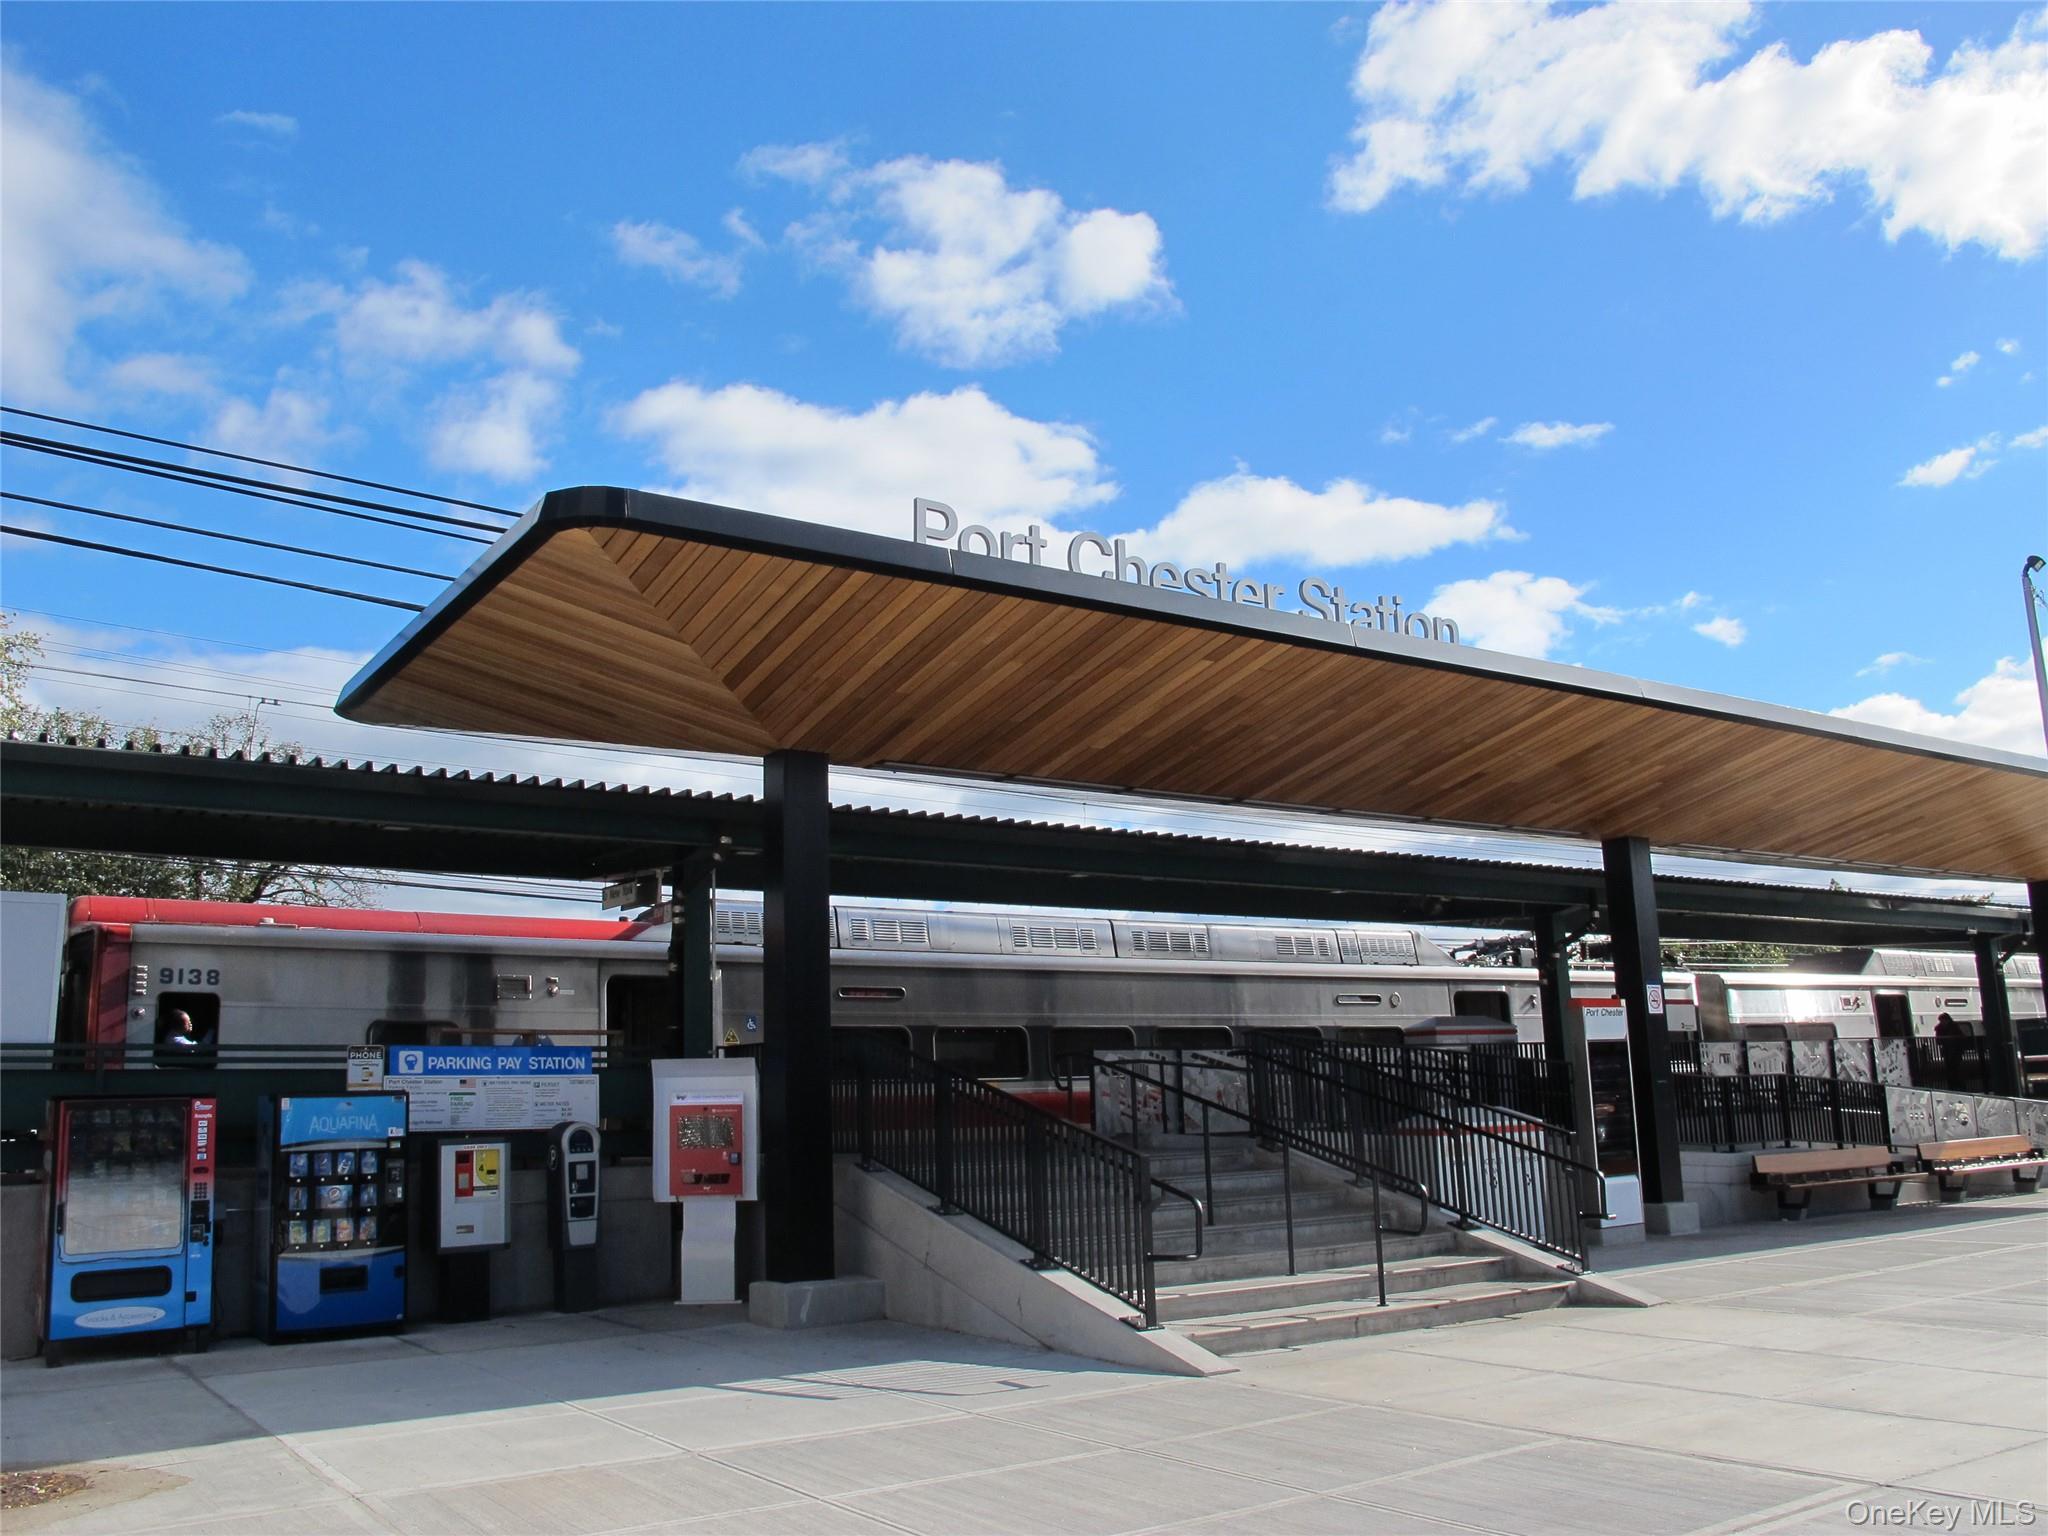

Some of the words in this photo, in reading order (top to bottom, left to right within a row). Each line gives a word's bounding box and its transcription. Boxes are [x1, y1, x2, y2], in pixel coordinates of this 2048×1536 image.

[914, 497, 1047, 567] Port
[1067, 532, 1285, 612] Chester
[1298, 576, 1460, 646] Station
[160, 967, 220, 986] 9138
[1585, 1008, 1599, 1017] Port
[1600, 1008, 1624, 1017] Chester
[350, 1051, 382, 1059] PHONE
[428, 1057, 492, 1070] PARKING
[498, 1057, 522, 1070] PAY
[528, 1056, 586, 1070] STATION
[309, 1113, 379, 1135] AQUAFINA
